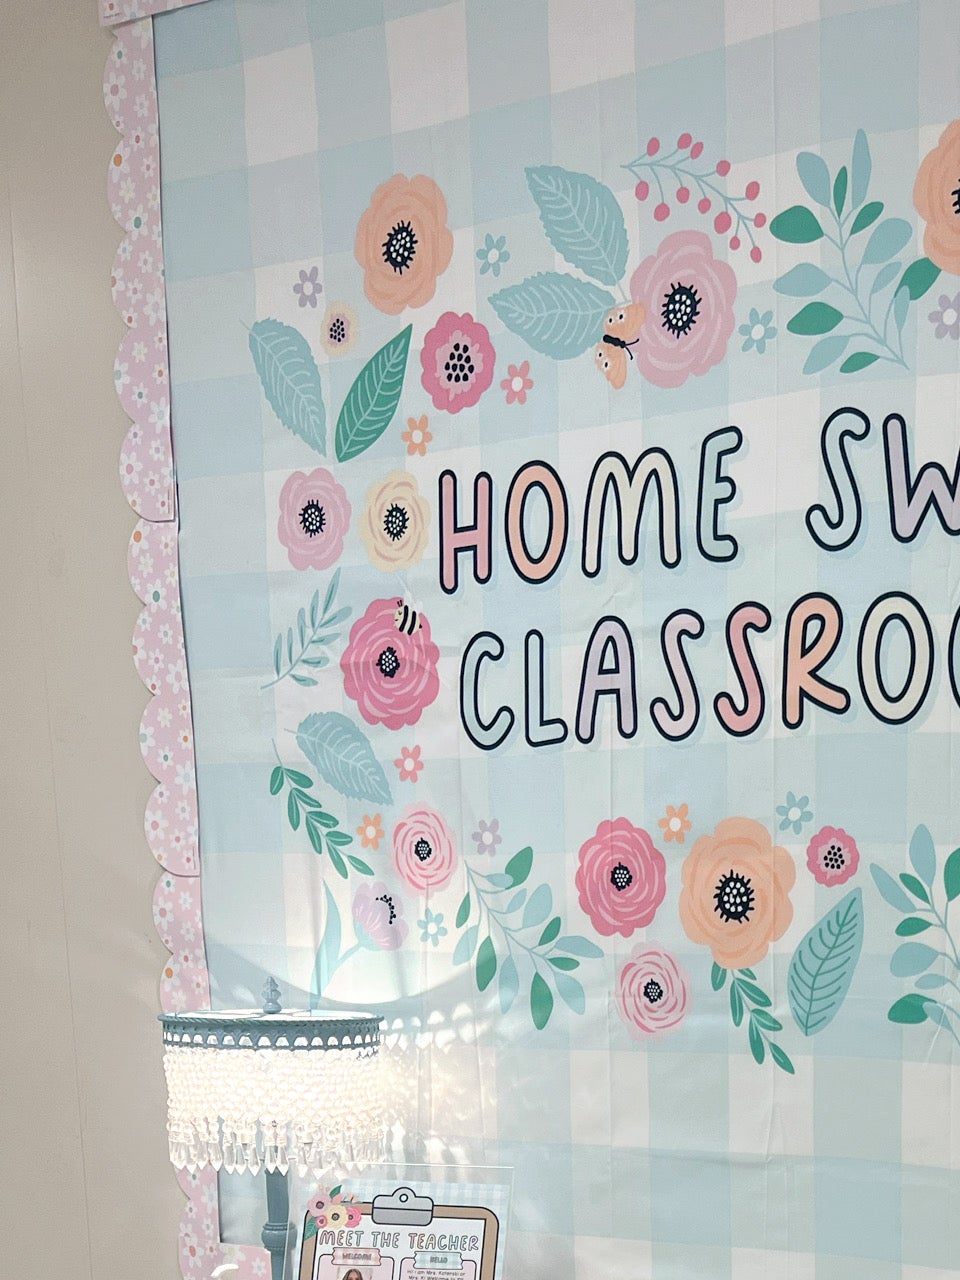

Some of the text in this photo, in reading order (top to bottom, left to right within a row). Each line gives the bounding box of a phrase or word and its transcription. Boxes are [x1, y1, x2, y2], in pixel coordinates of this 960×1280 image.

[439, 426, 743, 594] HOME
[319, 1230, 479, 1251] MEET THE TEACHER
[342, 1252, 373, 1261] WELCOME
[429, 1256, 448, 1264] HELLO
